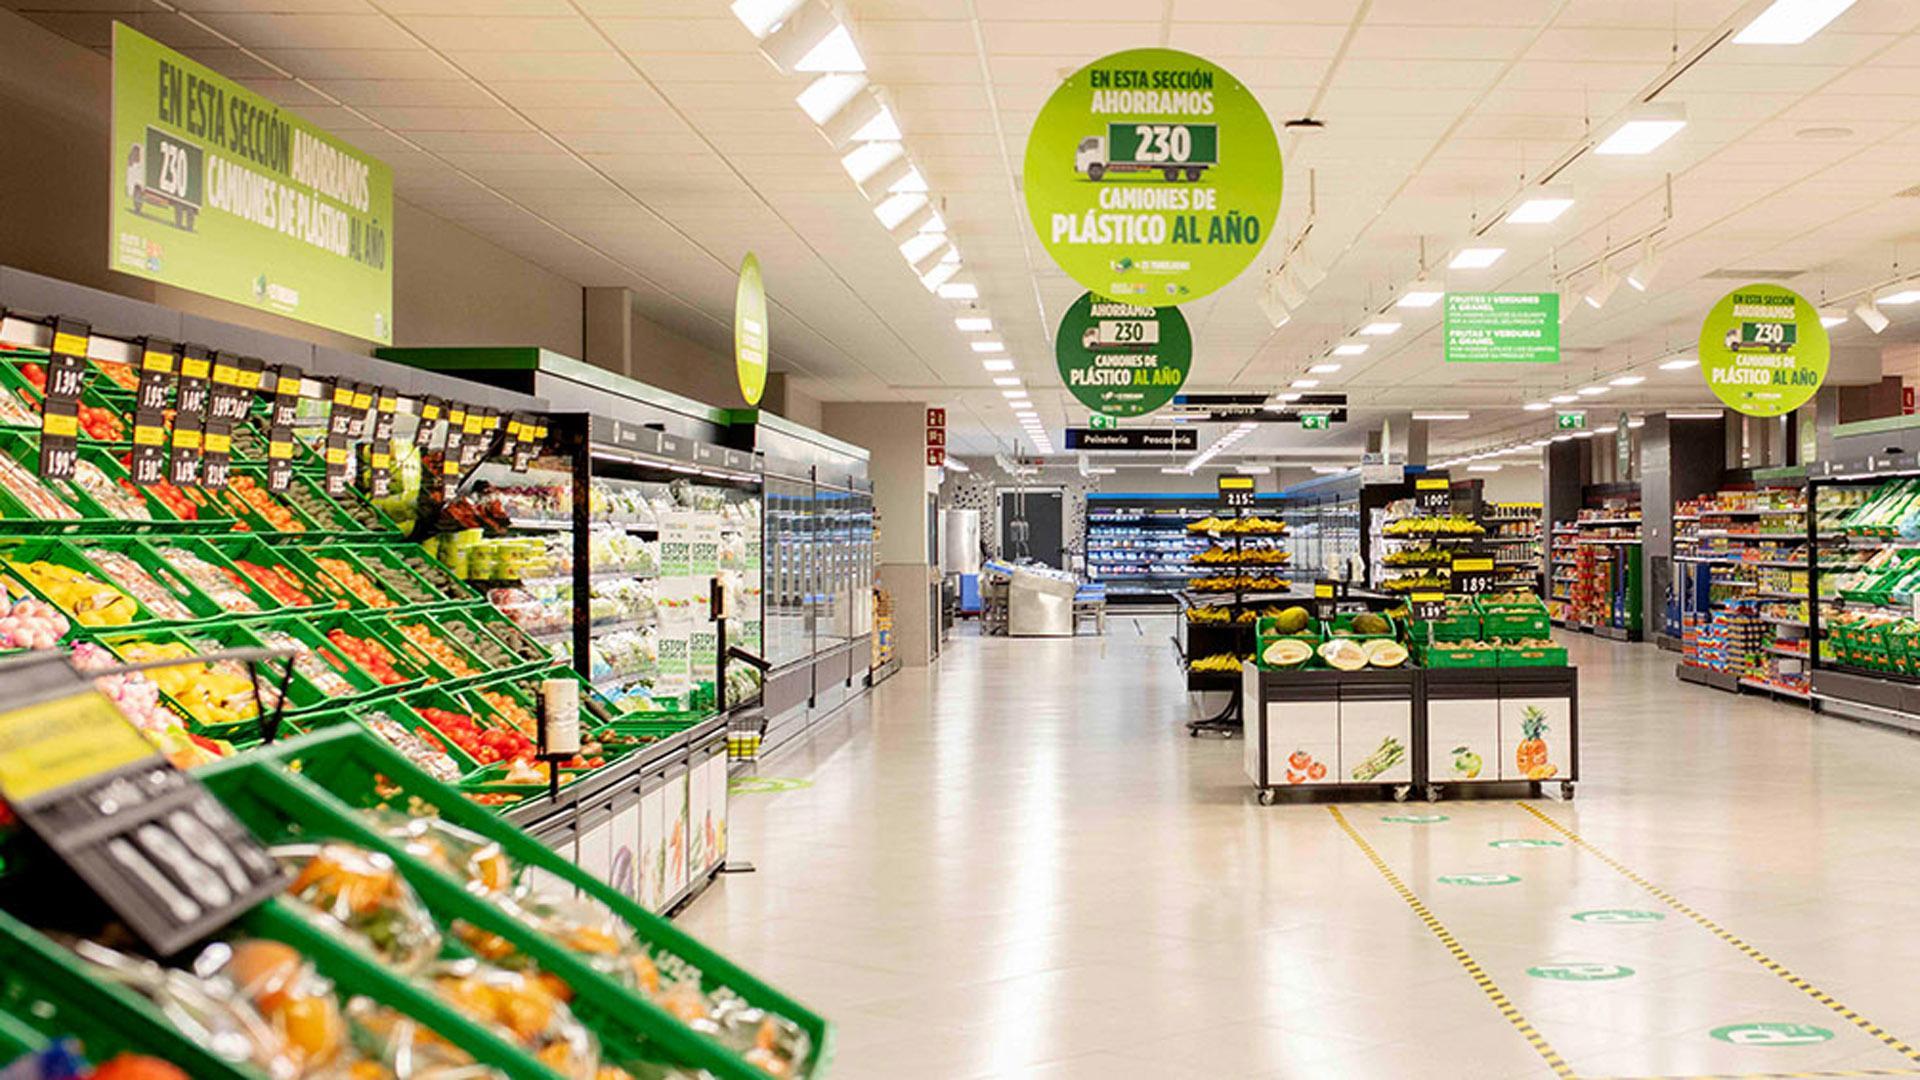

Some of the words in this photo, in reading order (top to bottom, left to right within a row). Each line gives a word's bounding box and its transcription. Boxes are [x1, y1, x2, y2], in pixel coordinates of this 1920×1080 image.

[1091, 70, 1110, 88] EN
[1114, 70, 1148, 88] ESTA
[1152, 68, 1213, 89] SECCIÓN
[1091, 91, 1214, 115] AHORRAMOS
[158, 60, 182, 128] EN
[186, 73, 225, 148] ESTA
[230, 109, 290, 177] SECCIÓN
[292, 128, 369, 212] AHORRAMOS
[1135, 125, 1192, 162] 230
[159, 141, 187, 198] 230
[207, 155, 276, 229] CAMIONES
[277, 184, 296, 238] DE
[295, 192, 350, 257] PLÁSTICO
[1100, 187, 1189, 210] CAMIONES
[1193, 188, 1216, 210] DE
[1051, 209, 1166, 244] PLÁSTICO
[1172, 215, 1201, 244] AL
[1208, 210, 1260, 244] AÑO
[1090, 304, 1157, 318] AHORRAMOS
[1115, 323, 1144, 341] 230
[1754, 323, 1784, 343] 230
[1095, 355, 1143, 367] CAMIONES
[1144, 355, 1158, 367] DE
[1736, 355, 1782, 368] CAMIONES
[1784, 356, 1796, 369] DE
[1070, 366, 1131, 386] PLÁSTICO
[1133, 369, 1150, 386] AL
[1152, 367, 1181, 386] AÑO
[1712, 367, 1770, 385] PLÁSTICO
[1772, 370, 1787, 385] AL
[1790, 367, 1818, 386] AÑO
